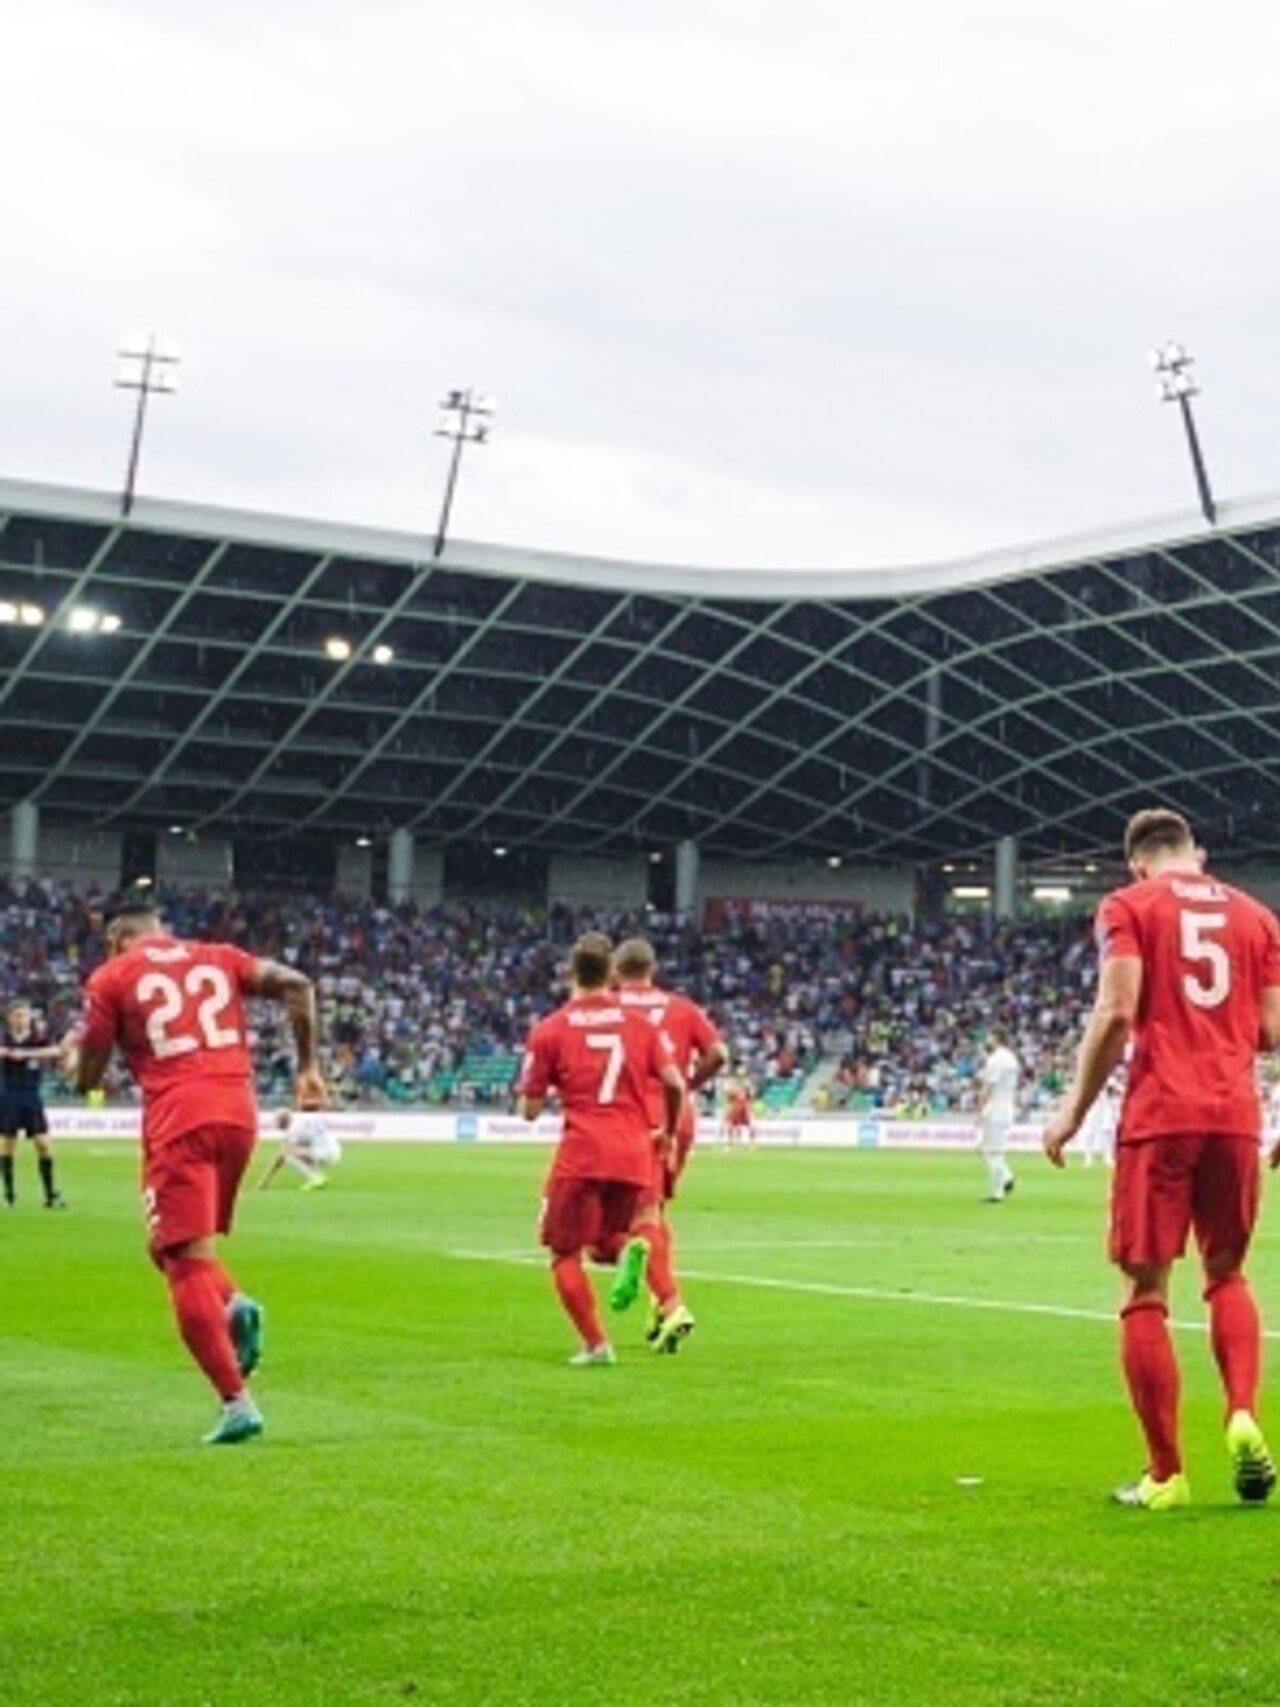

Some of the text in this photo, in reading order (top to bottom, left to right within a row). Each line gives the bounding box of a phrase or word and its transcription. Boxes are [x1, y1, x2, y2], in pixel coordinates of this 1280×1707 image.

[1180, 909, 1230, 1008] 5
[136, 964, 240, 1060] 22
[585, 1034, 624, 1104] 7
